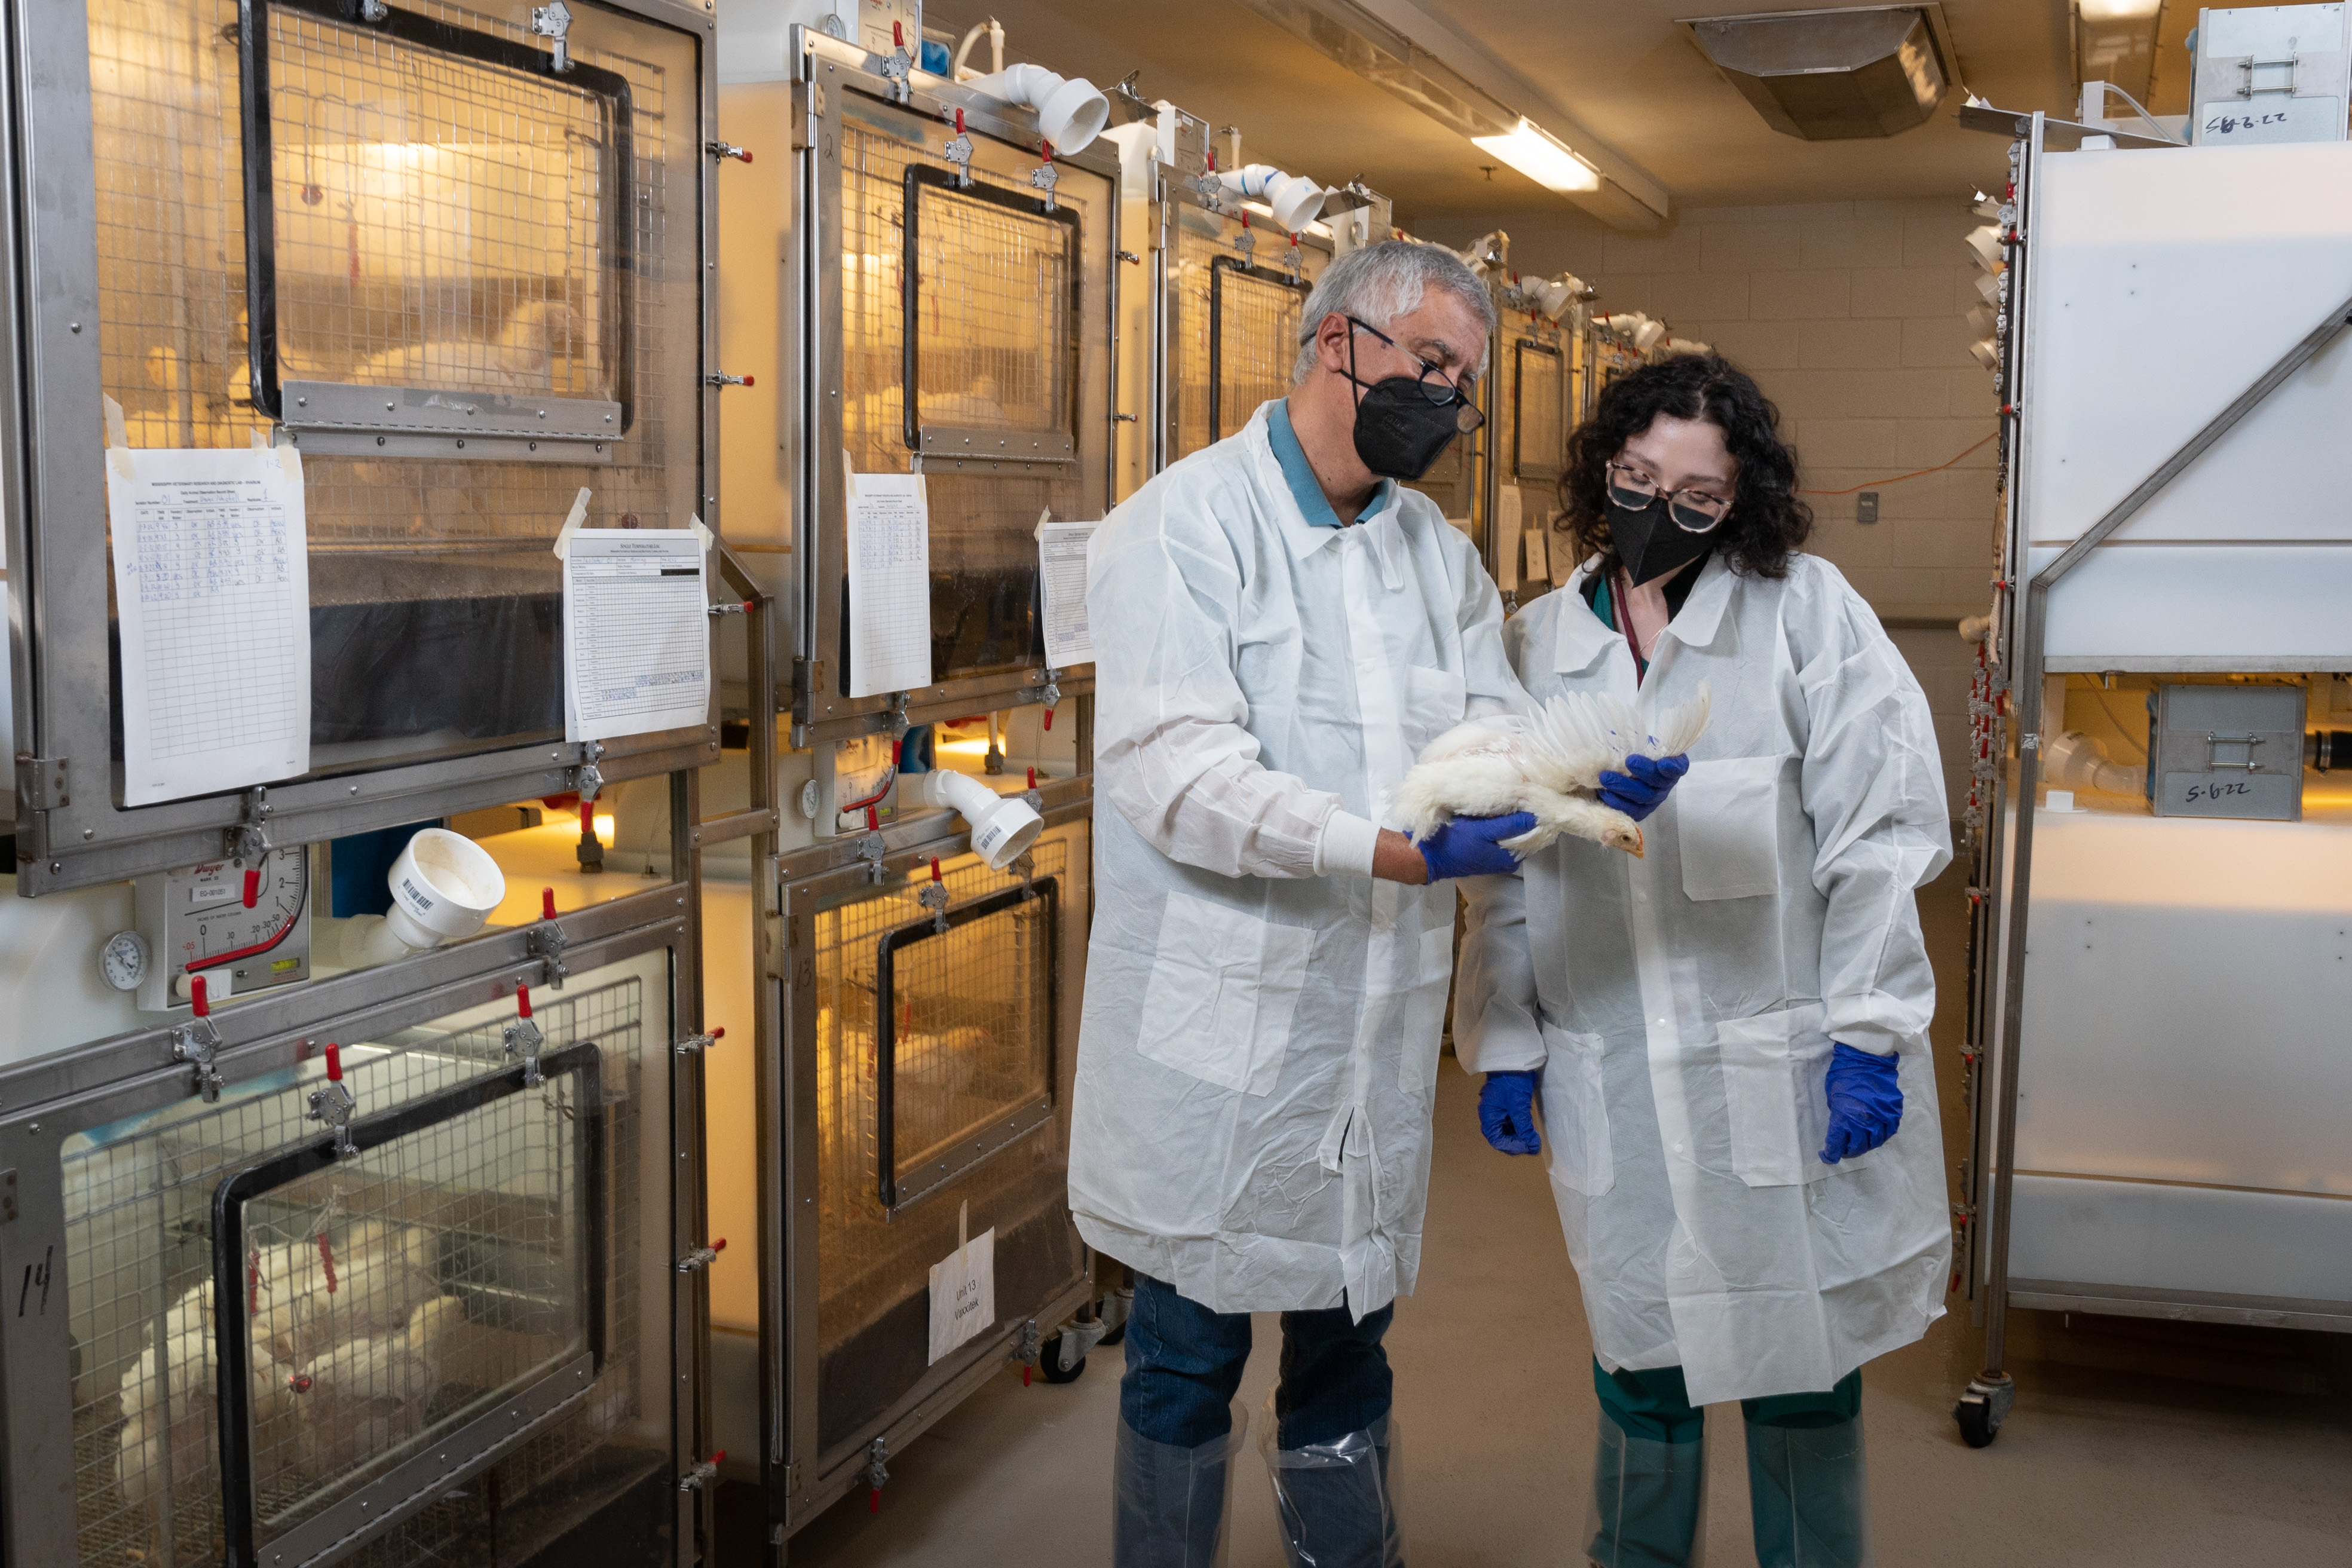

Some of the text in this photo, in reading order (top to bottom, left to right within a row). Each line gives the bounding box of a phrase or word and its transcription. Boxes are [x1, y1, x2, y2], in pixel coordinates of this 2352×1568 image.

[279, 849, 284, 860] 3
[194, 863, 225, 876] Dwyer
[279, 877, 284, 888] 2
[275, 896, 280, 907] 1
[200, 924, 207, 935] 0
[19, 1245, 54, 1318] 14
[957, 1279, 976, 1301] Unit 13
[955, 1297, 979, 1320] Vaxxitek
